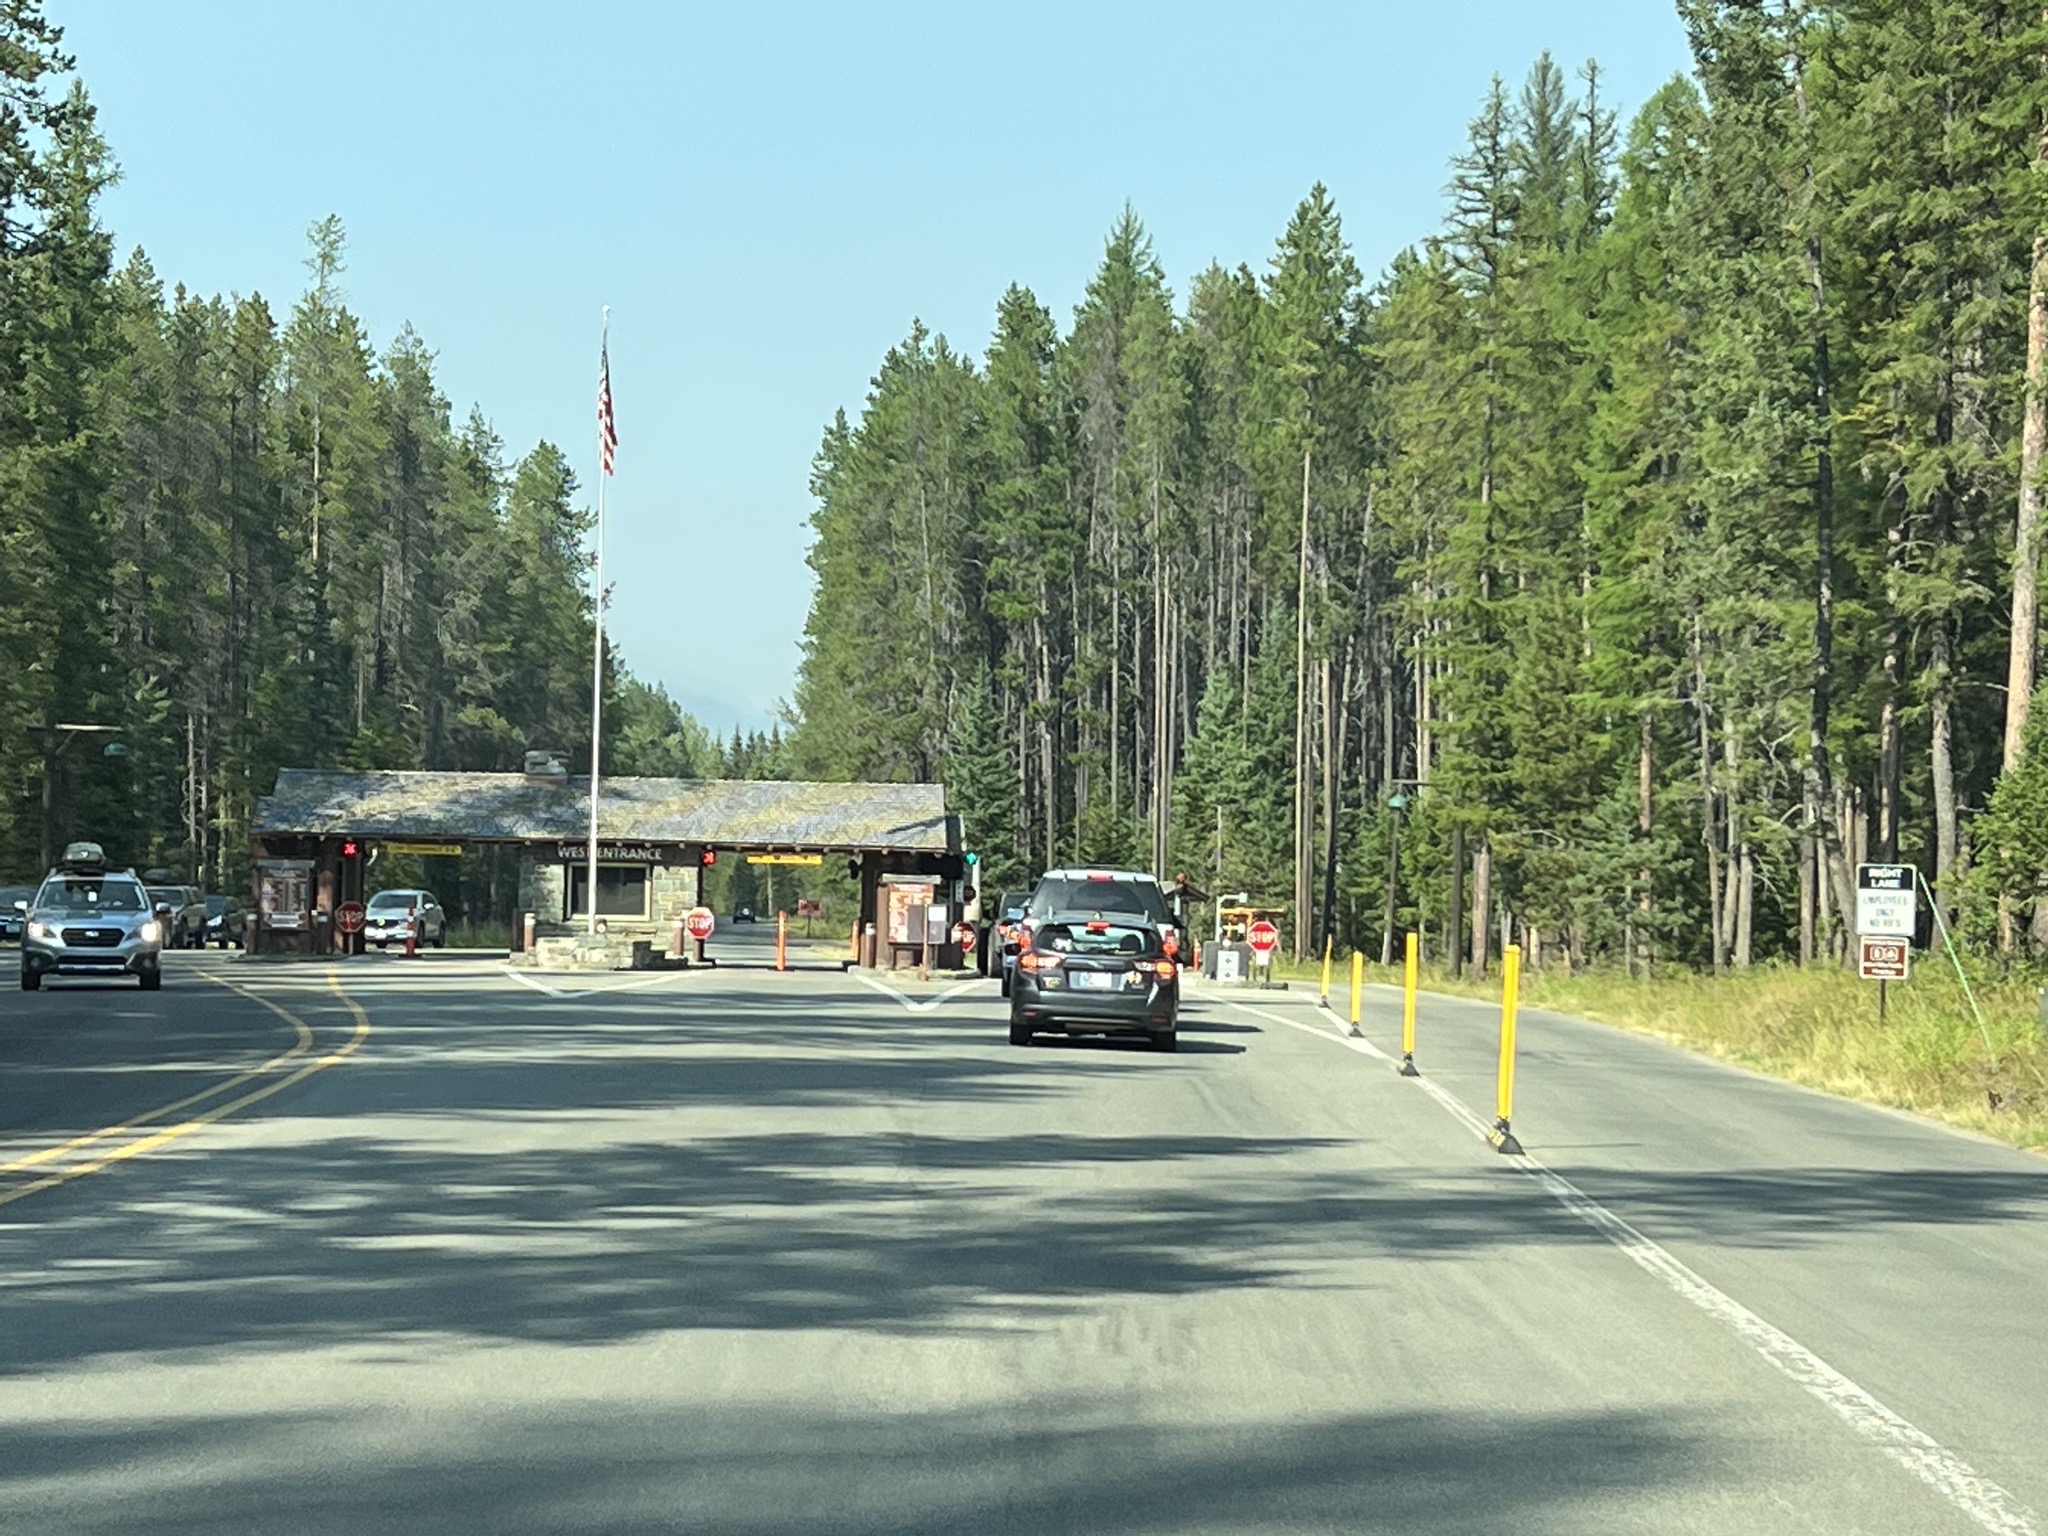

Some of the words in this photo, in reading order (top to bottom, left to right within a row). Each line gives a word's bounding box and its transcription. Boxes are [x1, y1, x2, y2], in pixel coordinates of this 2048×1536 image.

[596, 847, 662, 860] ENTRANCE
[1868, 868, 1904, 878] RIGHT
[1871, 879, 1901, 888] LANE
[334, 910, 364, 923] STOP
[688, 917, 713, 930] STOP
[1248, 931, 1277, 943] STOP
